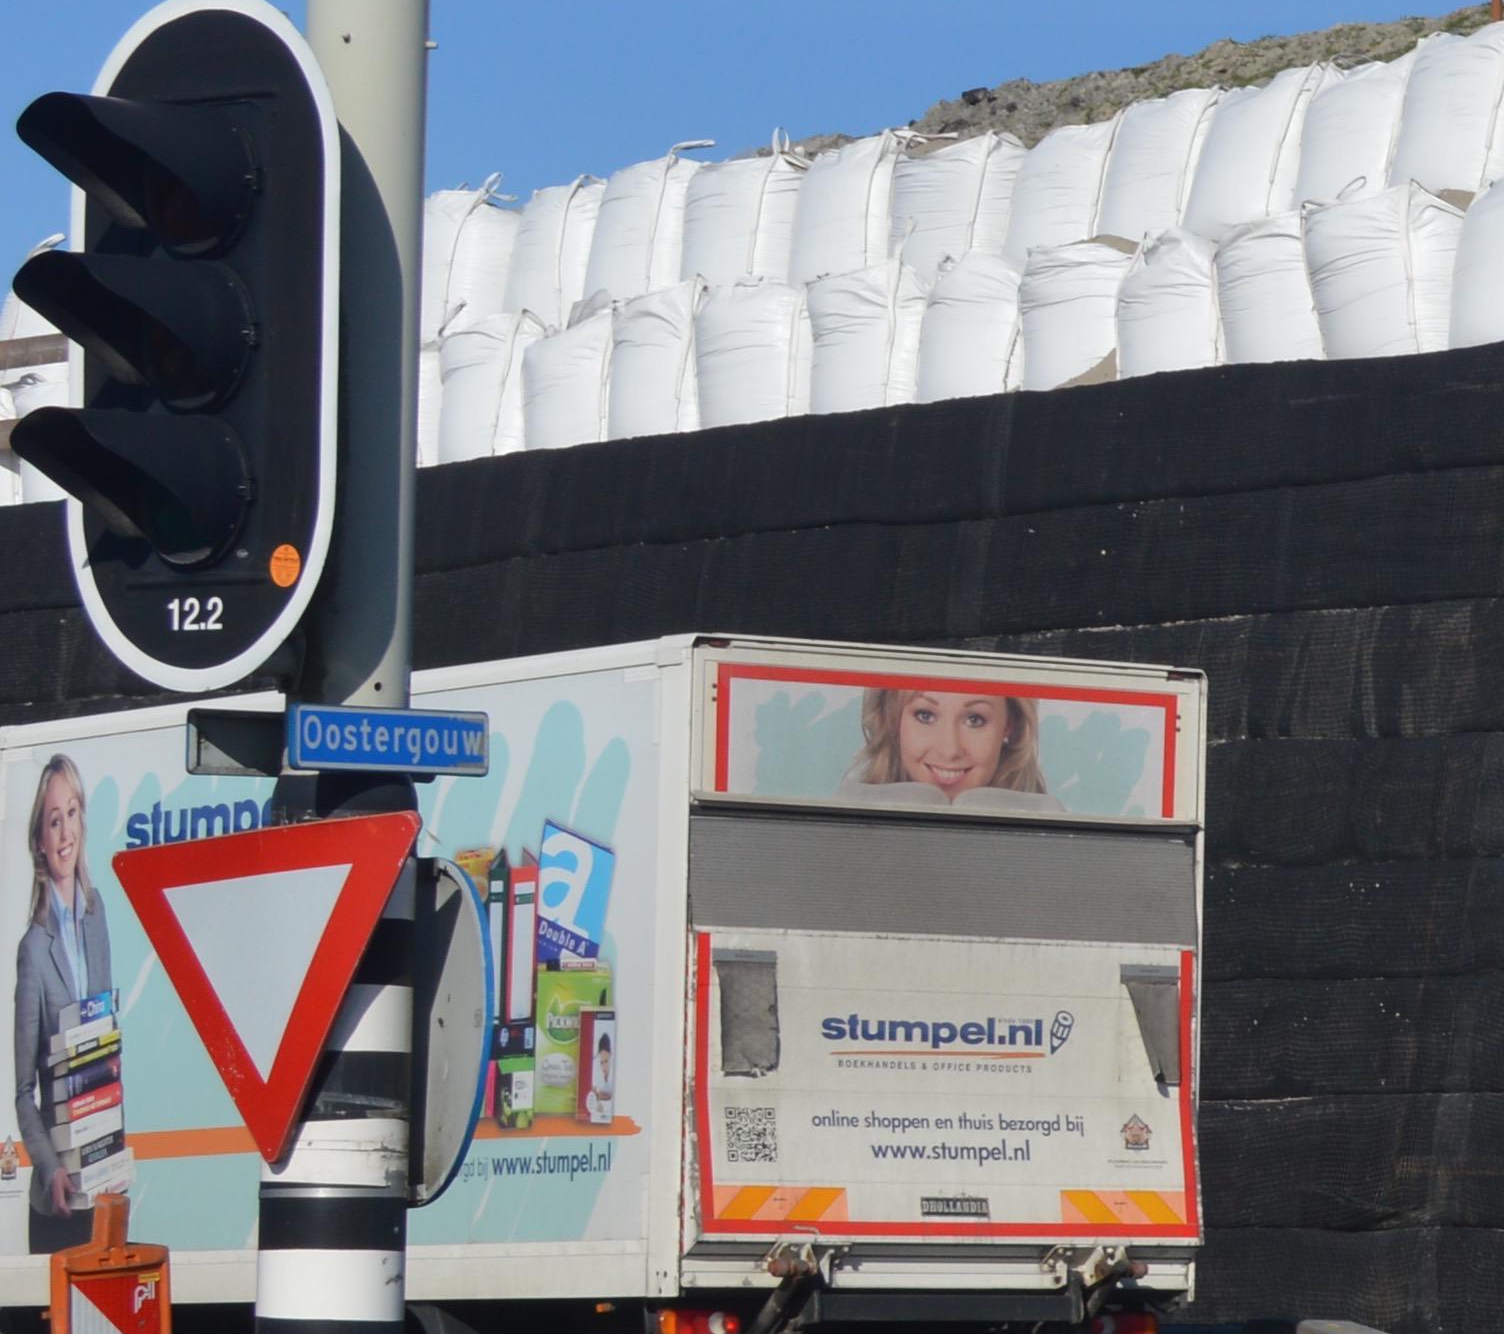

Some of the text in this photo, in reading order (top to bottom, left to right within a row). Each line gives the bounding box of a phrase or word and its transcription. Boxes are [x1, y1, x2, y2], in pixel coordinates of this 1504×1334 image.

[167, 596, 224, 631] 12.2
[303, 715, 485, 763] Oostergouw
[538, 921, 588, 956] Double A
[821, 1013, 1043, 1049] stumpel.nl
[838, 1059, 916, 1071] BOEKHANDELS
[932, 1062, 971, 1072] OFFICE
[976, 1063, 1032, 1073] PRODUCTS
[811, 1110, 1084, 1137] online shoppen en thuis bezorgd bij
[491, 1142, 612, 1181] www.stumpel.nl
[871, 1139, 1031, 1167] www.stumpel.nl
[921, 1199, 989, 1214] DHOLLANDIA
